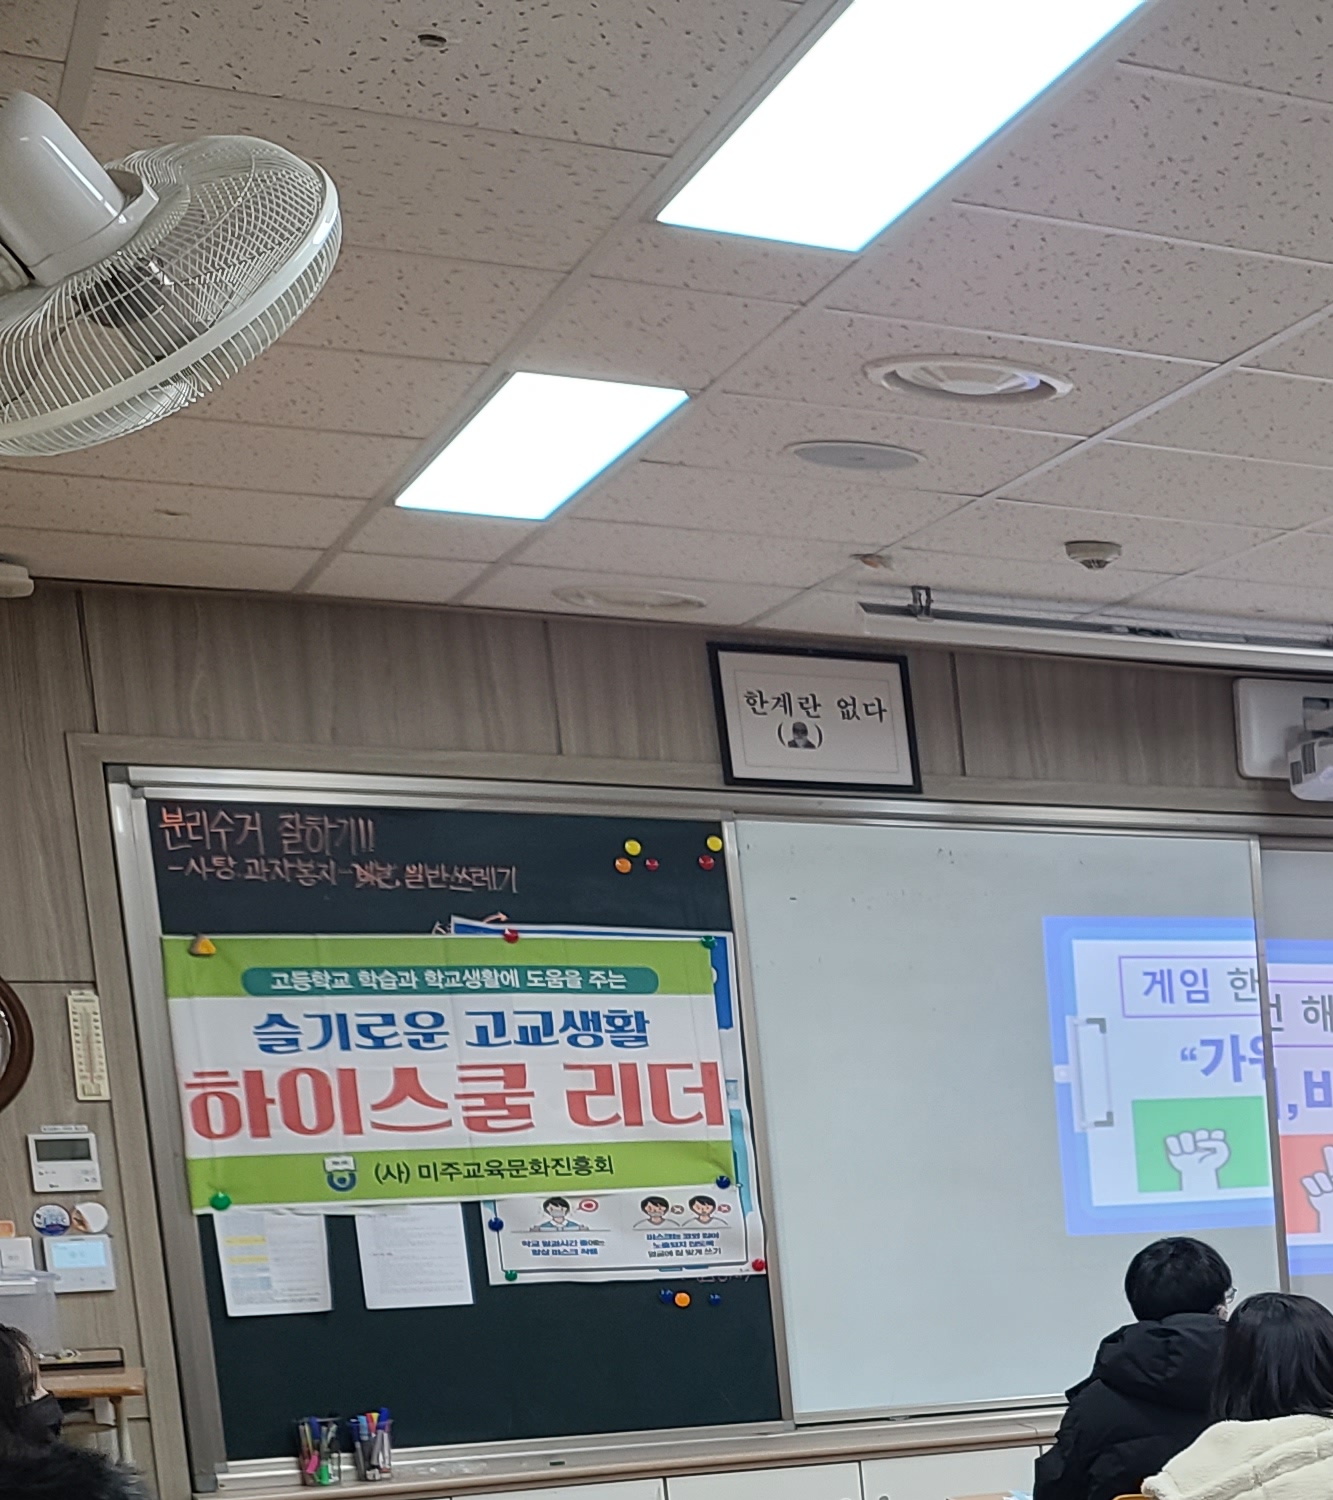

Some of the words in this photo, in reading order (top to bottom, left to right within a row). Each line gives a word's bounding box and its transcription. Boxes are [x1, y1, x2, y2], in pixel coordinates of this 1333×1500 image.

[743, 689, 822, 719] 한계란
[836, 695, 888, 723] 없다
[159, 806, 264, 854] 분리수거
[270, 969, 352, 991] 고등학교
[357, 967, 418, 992] 학습과
[424, 967, 520, 991] 학교생활에
[526, 968, 582, 991] 도움을
[587, 969, 627, 991] 주는
[1142, 967, 1210, 1004] 게임
[252, 1010, 450, 1055] 슬기로운
[464, 1008, 650, 1049] 고교생활
[183, 1062, 536, 1141] 하이스쿨
[563, 1061, 726, 1129] 리더
[373, 1161, 411, 1187] (사)
[418, 1154, 615, 1183] 미주교육문화진흥회
